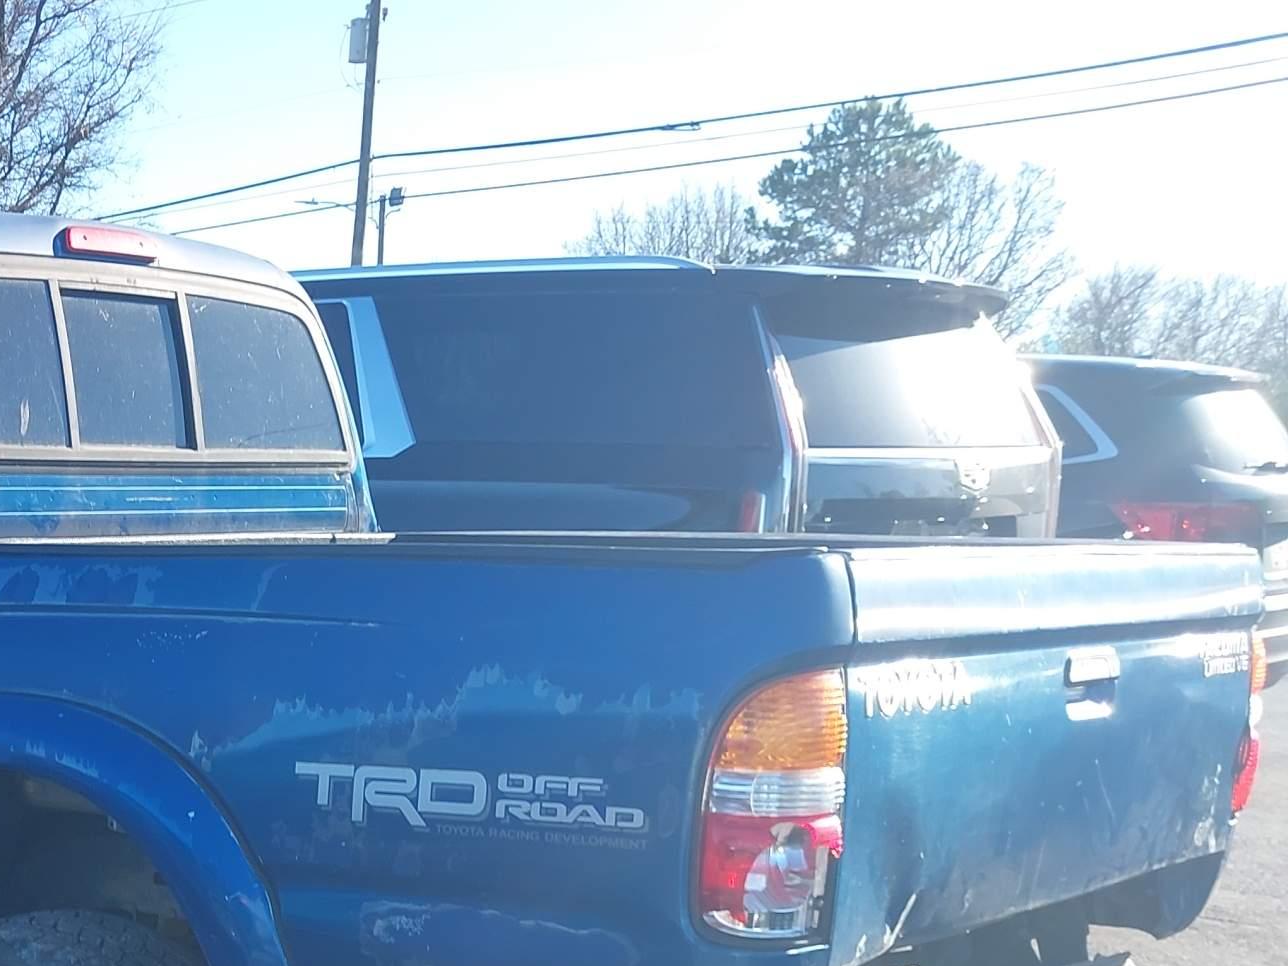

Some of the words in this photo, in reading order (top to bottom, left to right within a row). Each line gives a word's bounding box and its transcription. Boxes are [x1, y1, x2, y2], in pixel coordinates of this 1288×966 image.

[856, 661, 973, 720] TOYOTA
[295, 761, 488, 832] TRD
[496, 772, 608, 798] OFF
[495, 799, 649, 833] ROAD
[436, 823, 485, 838] TOYOTA
[489, 828, 540, 841] RACING
[544, 832, 648, 850] DEVELOPMENT
